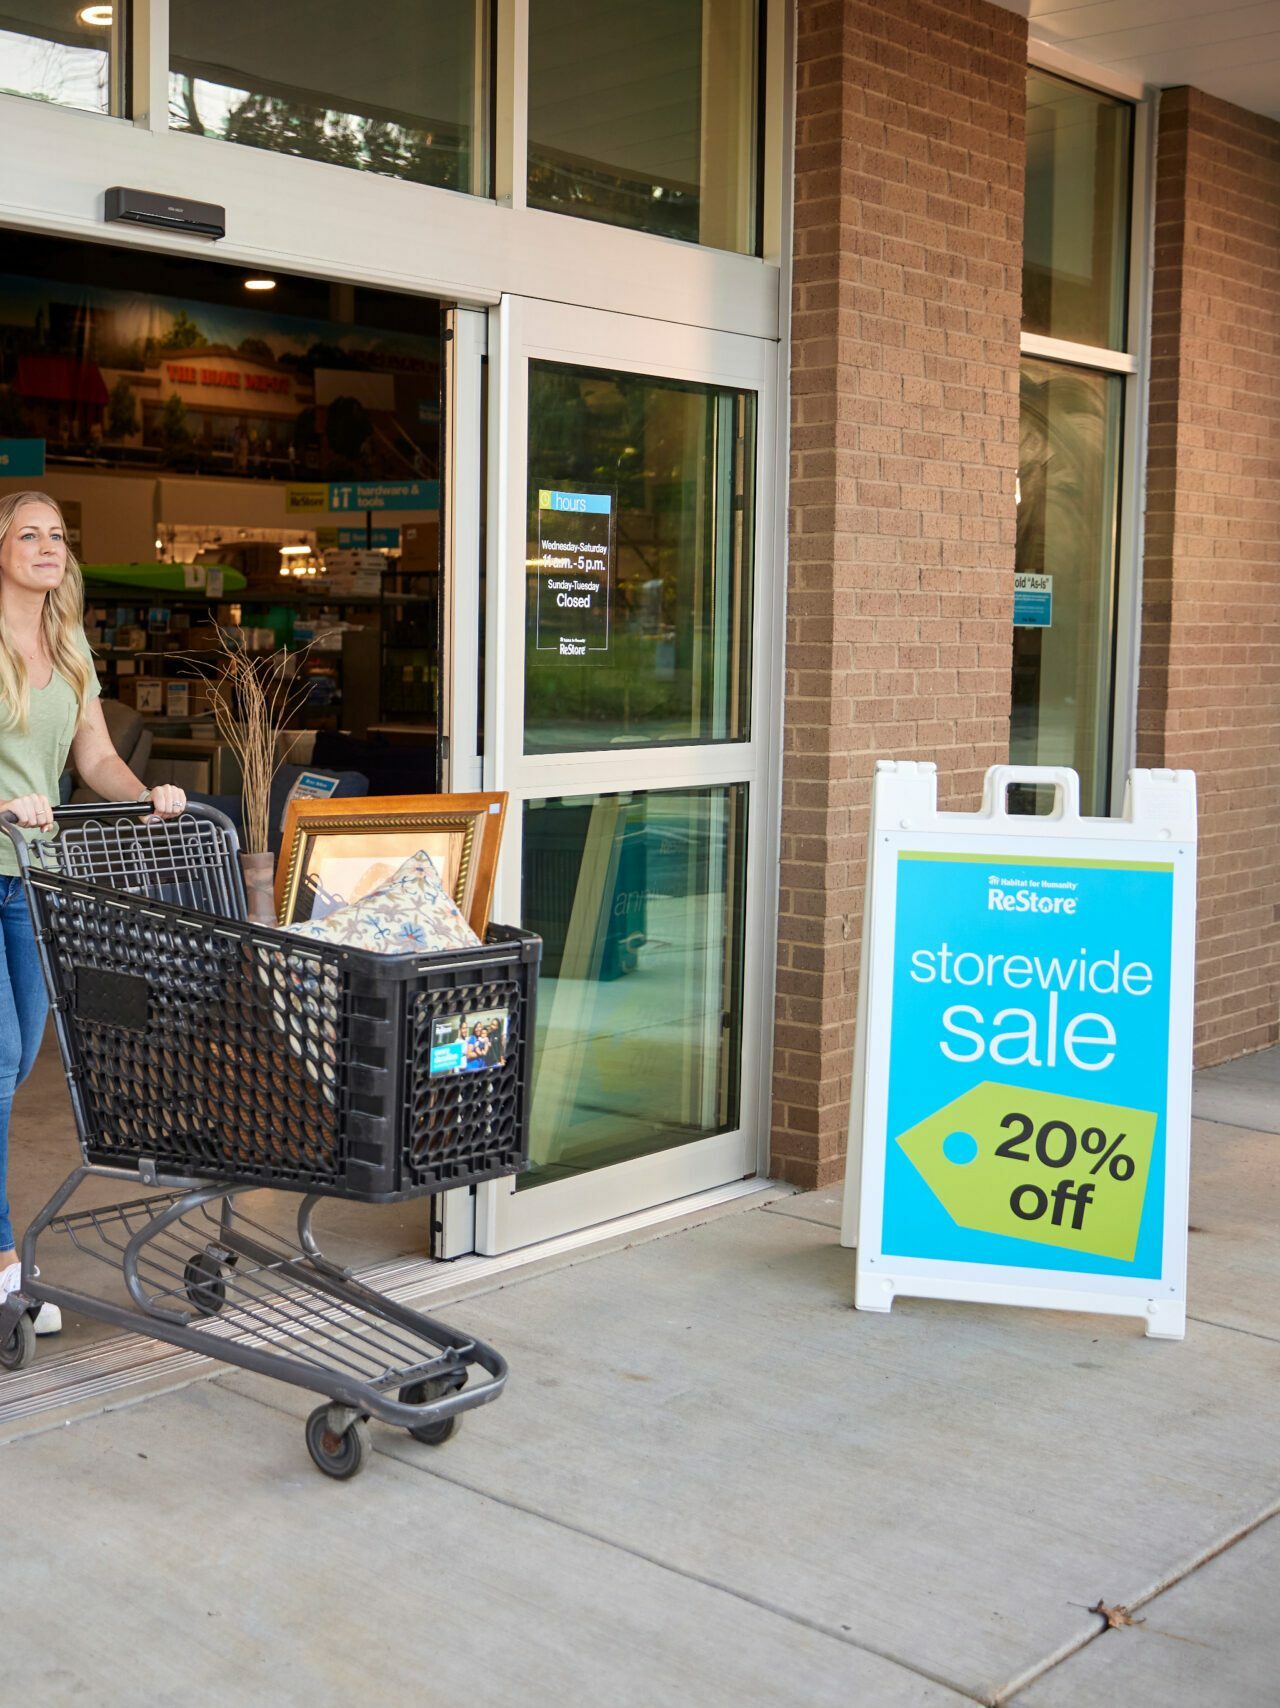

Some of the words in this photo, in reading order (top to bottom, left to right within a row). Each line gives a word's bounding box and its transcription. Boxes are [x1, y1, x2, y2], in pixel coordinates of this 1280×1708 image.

[356, 485, 409, 496] hardware
[357, 497, 385, 507] tools
[555, 492, 586, 512] hours
[541, 539, 607, 555] Wednesday-Saturday
[548, 579, 600, 592] Sunday-Tuesday
[1014, 577, 1026, 588] old
[556, 593, 591, 608] Closed
[559, 643, 586, 655] ReStore
[1000, 878, 1028, 887] Habitat
[1029, 879, 1040, 887] for
[1041, 880, 1077, 891] Humanity
[987, 888, 1077, 915] ReStore
[909, 942, 1153, 996] storewide
[939, 991, 1117, 1072] sale
[994, 1112, 1136, 1182] 20%
[1009, 1179, 1096, 1231] off
